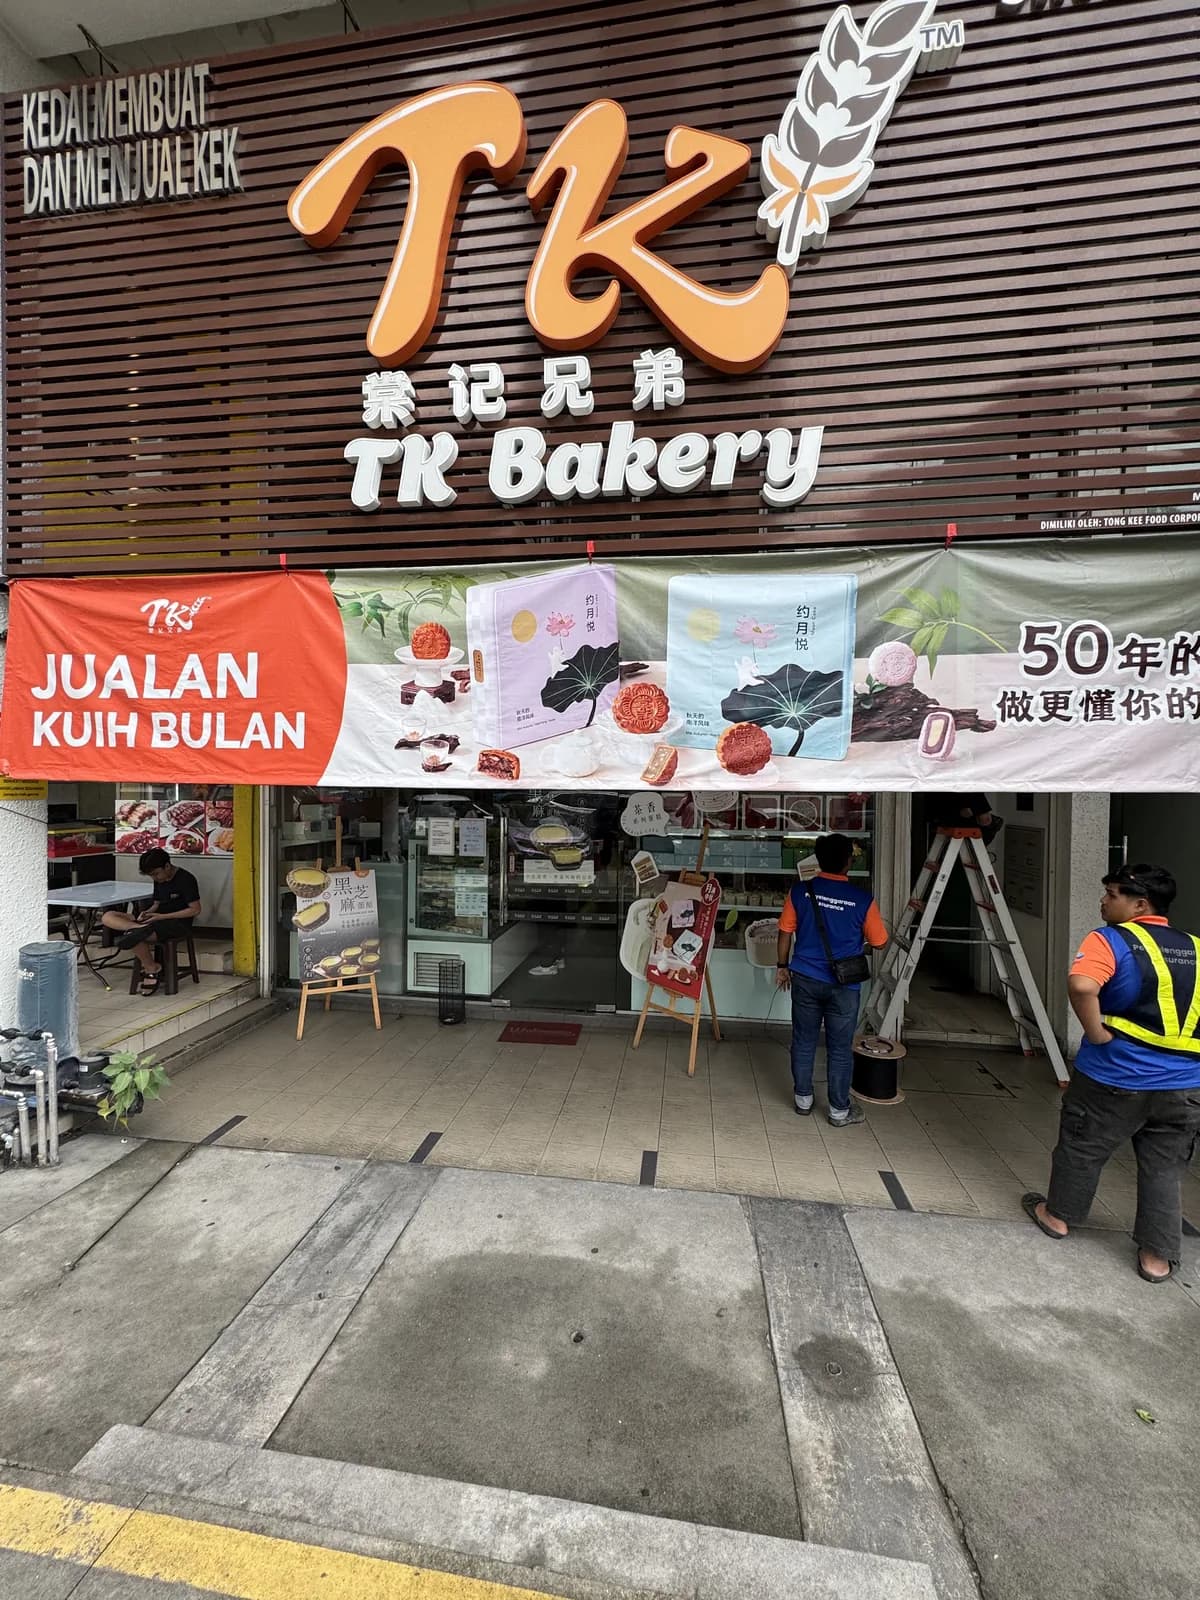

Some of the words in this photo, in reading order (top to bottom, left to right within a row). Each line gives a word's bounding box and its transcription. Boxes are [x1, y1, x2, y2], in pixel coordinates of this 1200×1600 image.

[919, 23, 962, 49] TM
[23, 85, 88, 149] KEDAI
[94, 63, 209, 140] MEMBUAT
[23, 152, 71, 214] DAN
[76, 136, 190, 207] MENJUAL
[194, 127, 240, 192] KEK
[287, 80, 790, 375] TK
[344, 430, 458, 512] TK
[488, 420, 825, 508] Bakery
[1040, 519, 1076, 530] DIMILIKI
[1077, 517, 1102, 528] OLEH:
[1104, 516, 1126, 527] TONG
[1127, 514, 1143, 526] KEE
[1145, 513, 1168, 525] FOOD
[795, 604, 810, 651] 约月悦
[30, 652, 259, 700] JUALAN
[32, 711, 138, 748] KUIH
[151, 711, 306, 749] BULAN
